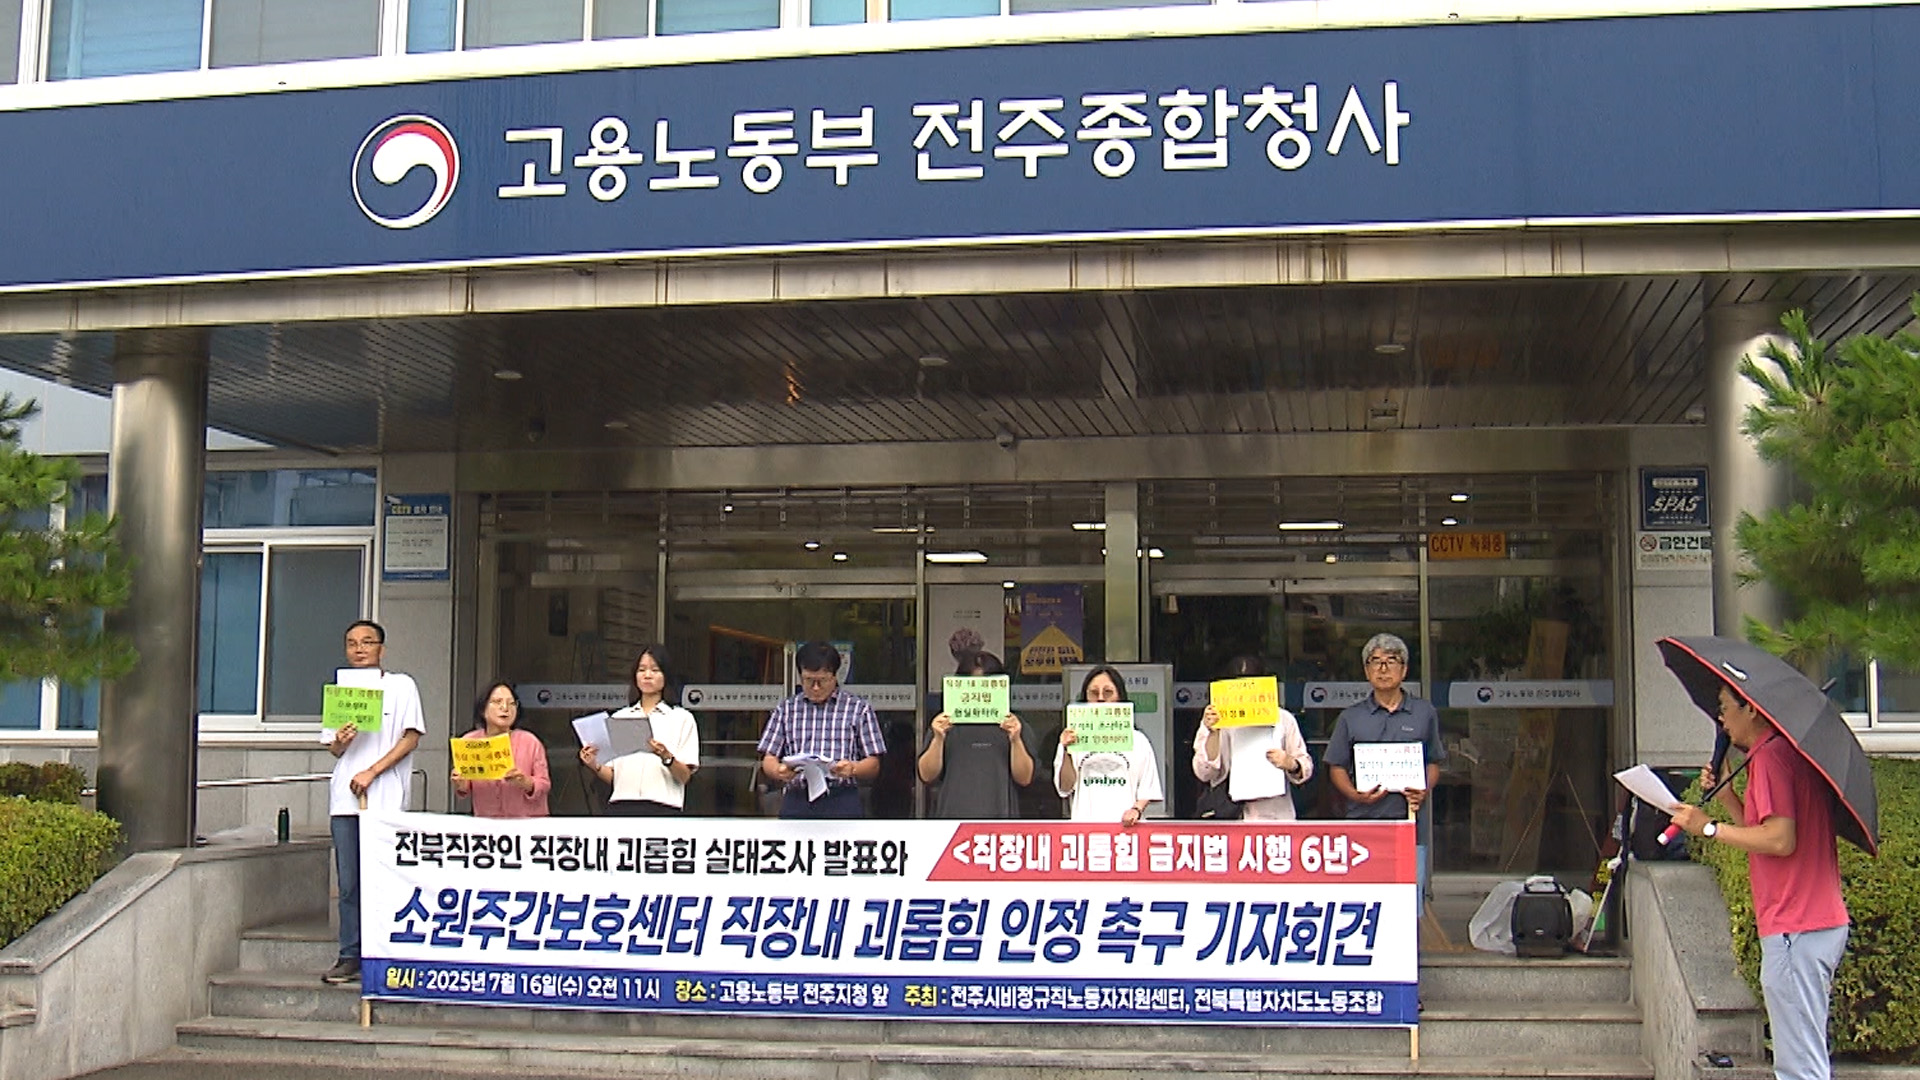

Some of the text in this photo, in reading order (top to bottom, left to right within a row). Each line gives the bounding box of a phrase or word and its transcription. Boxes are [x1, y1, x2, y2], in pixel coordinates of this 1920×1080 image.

[498, 80, 1411, 201] 고용노동부 전주종합청사
[1431, 533, 1502, 552] CCTV 녹화중
[947, 679, 962, 688] 직장
[981, 679, 1007, 688] 괴롭힘
[961, 692, 992, 704] 금지법
[954, 708, 999, 718] 현실화하라
[1083, 774, 1126, 787] umbro
[395, 830, 909, 877] 전북직장인 직장내 괴롭힘 실태조사 발표와
[952, 832, 1371, 875] <직장내 괴롭힘 금지법 시행 6년>
[389, 886, 1382, 967] 소원주간보호센터 직장내 괴롭힘 인정 촉구 기자회견
[426, 969, 487, 992] 2025년
[488, 972, 516, 995] 7월
[520, 973, 583, 998] 16일(수)
[586, 978, 618, 999] 오전
[622, 977, 661, 1000] 11시
[719, 980, 800, 1004] 고용노동부
[802, 982, 868, 1006] 전주지청
[871, 983, 890, 1007] 앞
[950, 984, 1191, 1014] 전주시비정규직노동자지원센터,
[1194, 987, 1385, 1015] 전북특별자치도노동조합
